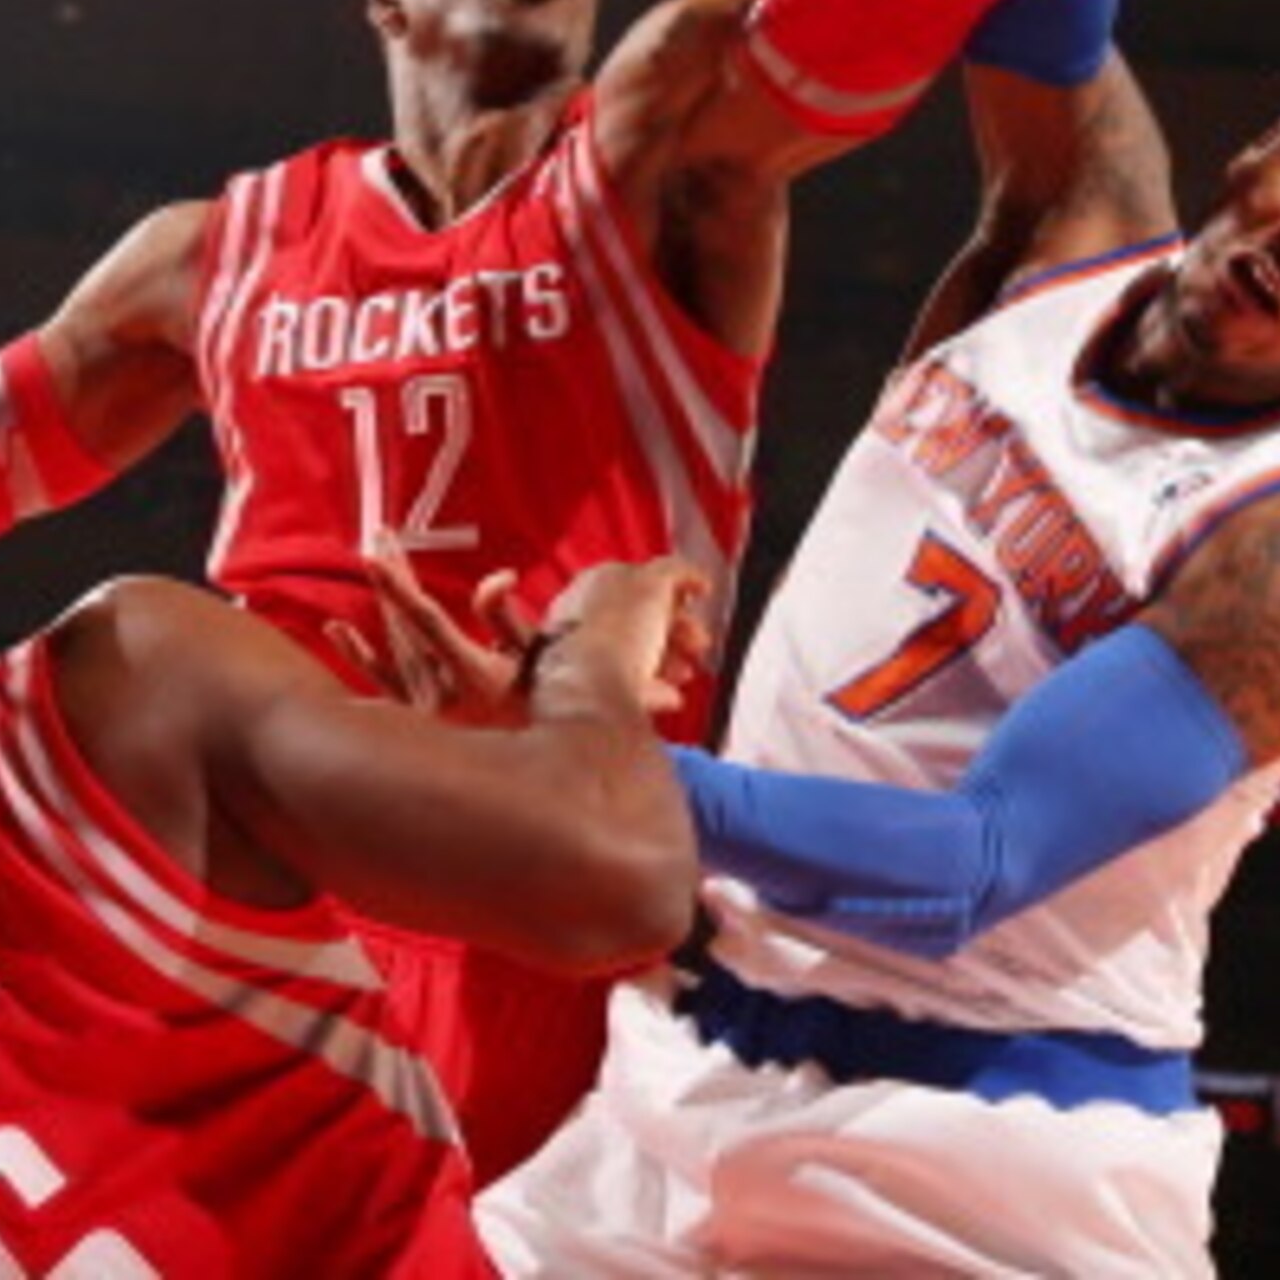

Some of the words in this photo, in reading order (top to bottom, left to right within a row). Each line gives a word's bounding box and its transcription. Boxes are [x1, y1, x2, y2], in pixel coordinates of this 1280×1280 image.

[254, 260, 570, 378] ROCKETS
[340, 373, 480, 560] 12
[823, 526, 1004, 724] 7
